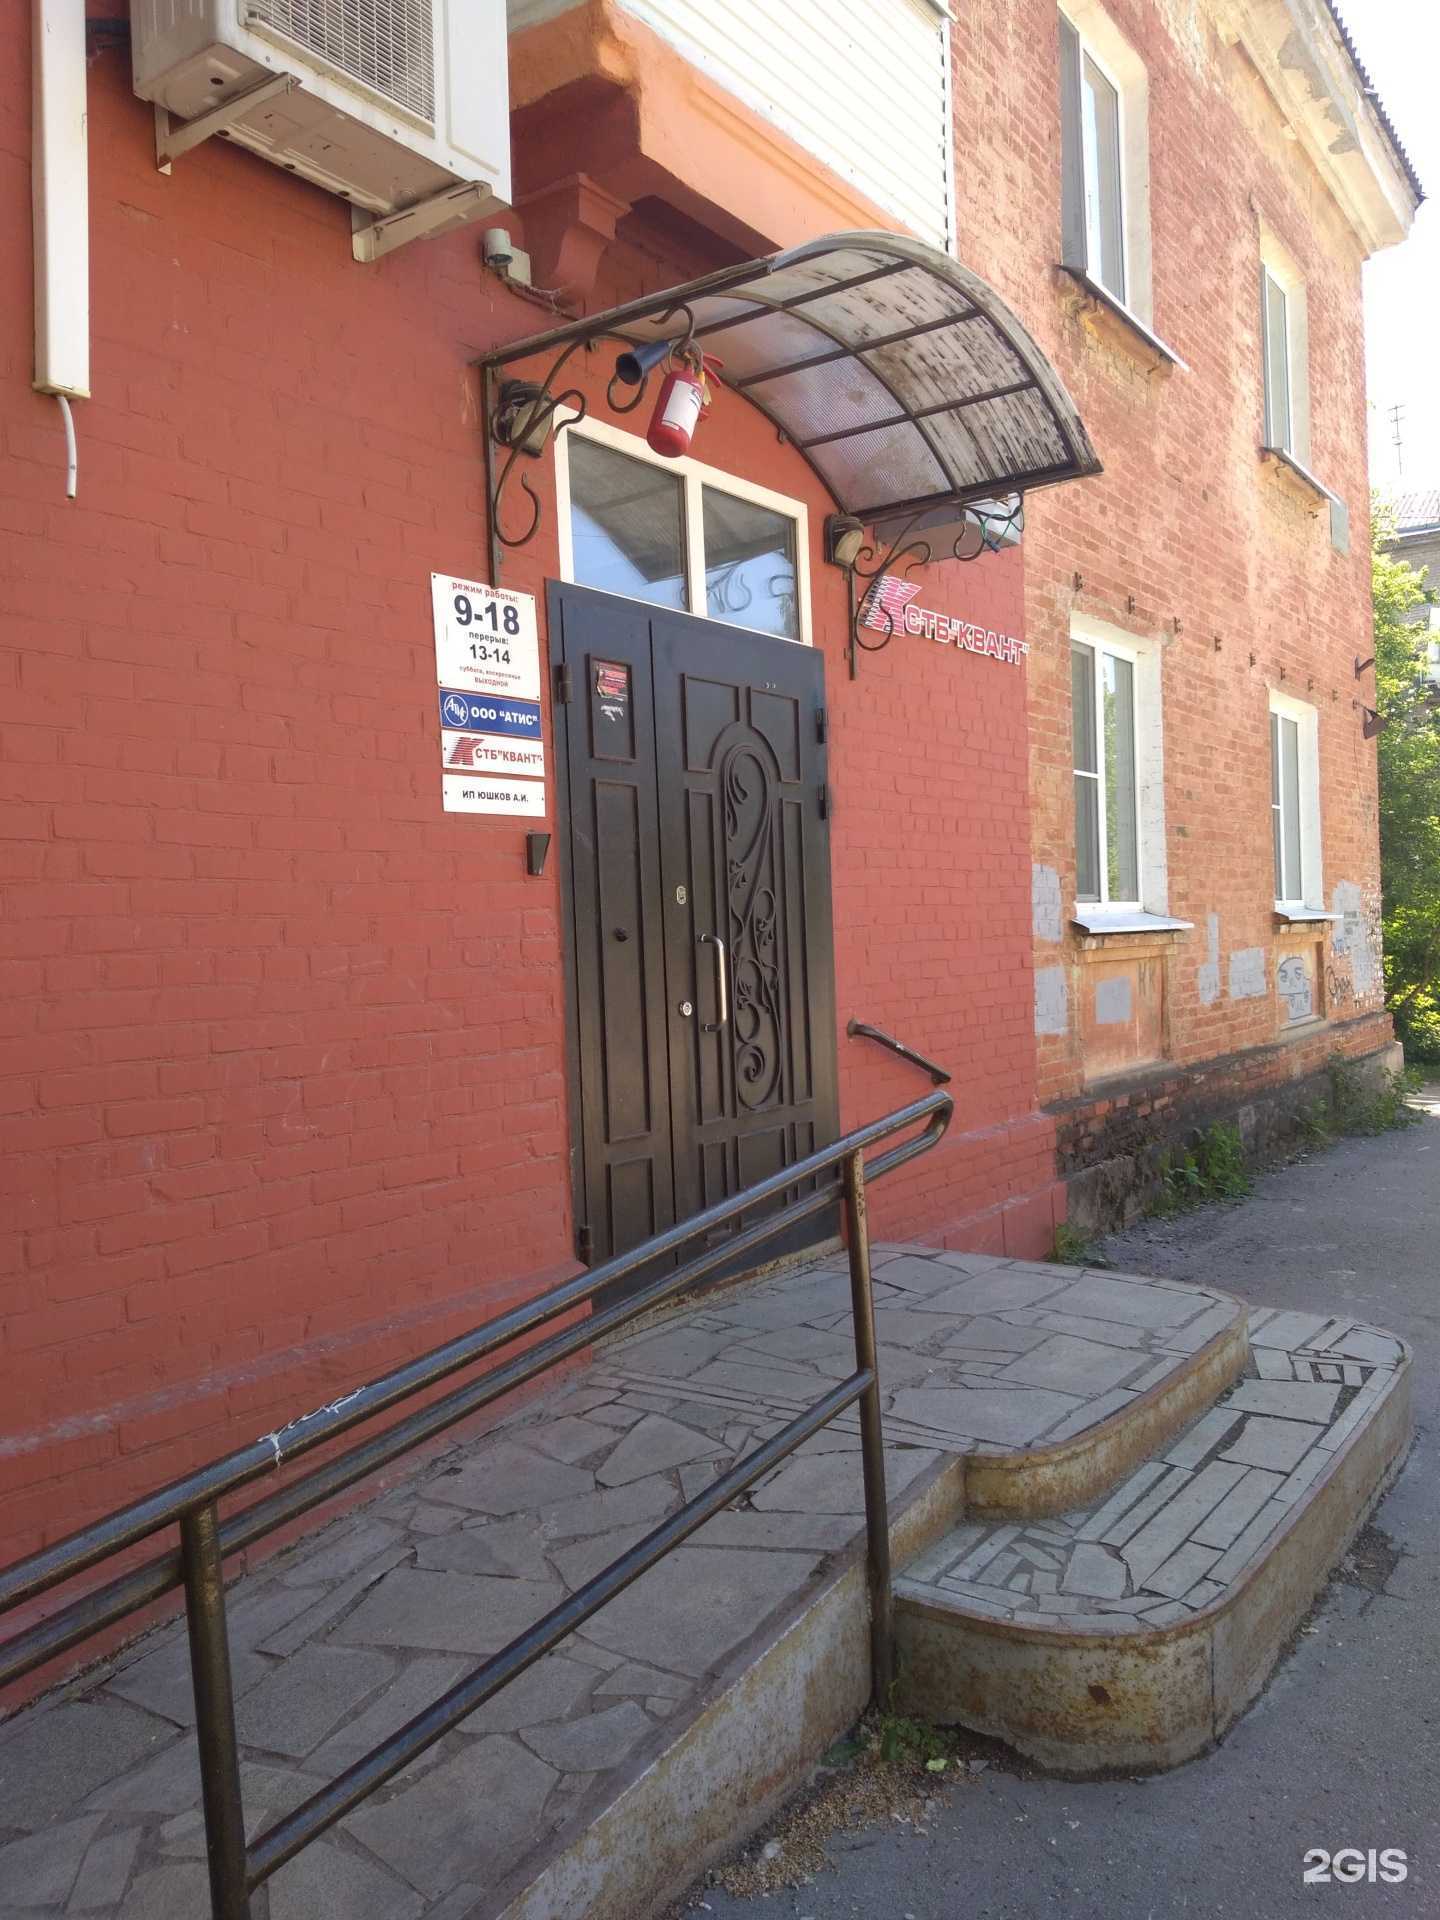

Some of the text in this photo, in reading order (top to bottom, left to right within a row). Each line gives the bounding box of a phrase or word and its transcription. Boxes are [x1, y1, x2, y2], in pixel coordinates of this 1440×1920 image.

[452, 582, 482, 594] режим
[453, 594, 520, 636] 9-18
[469, 643, 511, 665] 13-14
[470, 706, 497, 720] ООО
[462, 789, 529, 803] ИП ЮШКОВ А.И.
